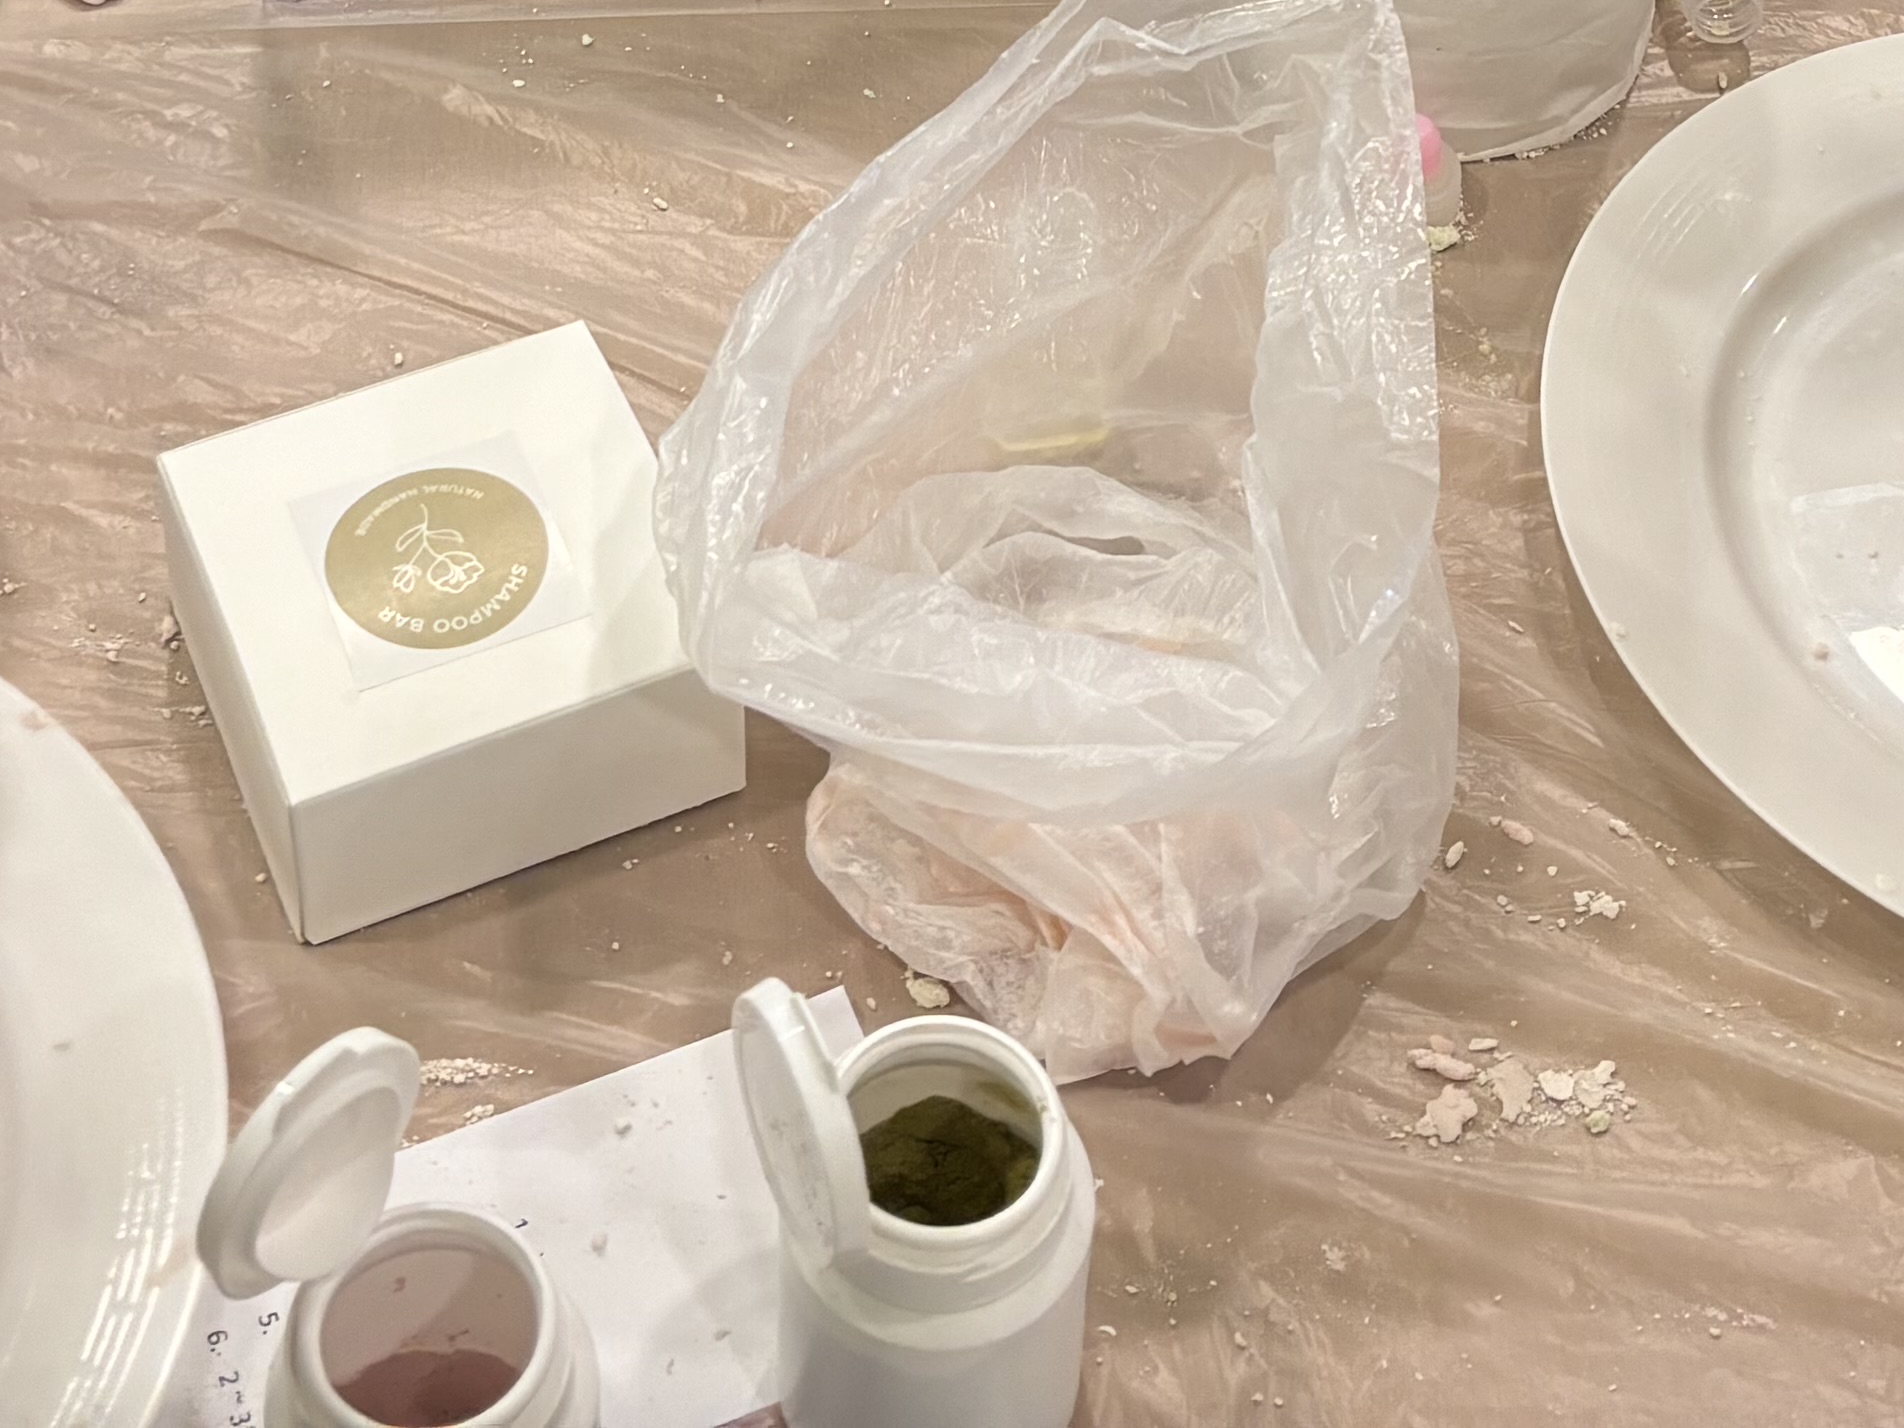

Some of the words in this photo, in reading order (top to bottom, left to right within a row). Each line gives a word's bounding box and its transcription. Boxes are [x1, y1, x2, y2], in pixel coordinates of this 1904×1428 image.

[422, 484, 485, 501] NATURAL
[432, 563, 529, 634] SHAMPOO
[377, 605, 426, 634] BAR
